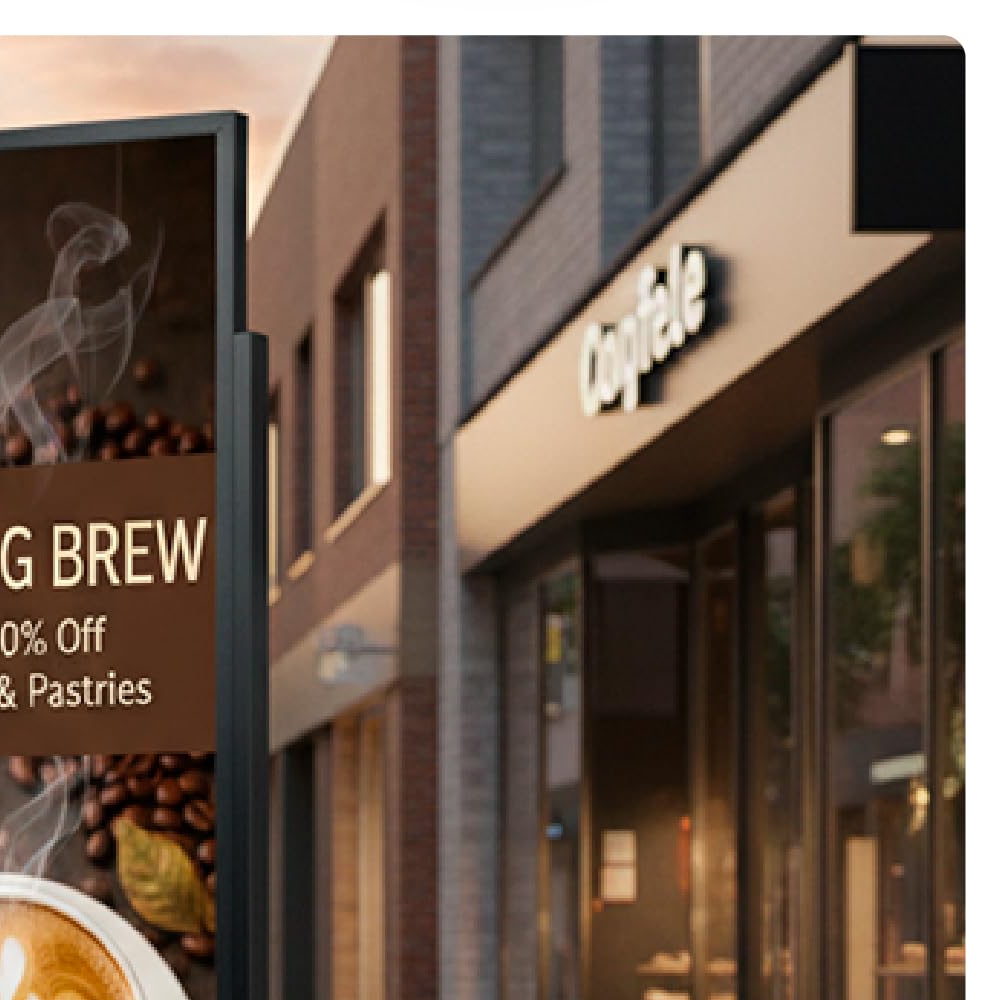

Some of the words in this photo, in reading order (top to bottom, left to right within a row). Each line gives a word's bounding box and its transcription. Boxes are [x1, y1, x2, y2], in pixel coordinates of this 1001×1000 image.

[53, 517, 206, 586] BREW
[58, 615, 107, 652] Off
[30, 670, 151, 707] Pastries
